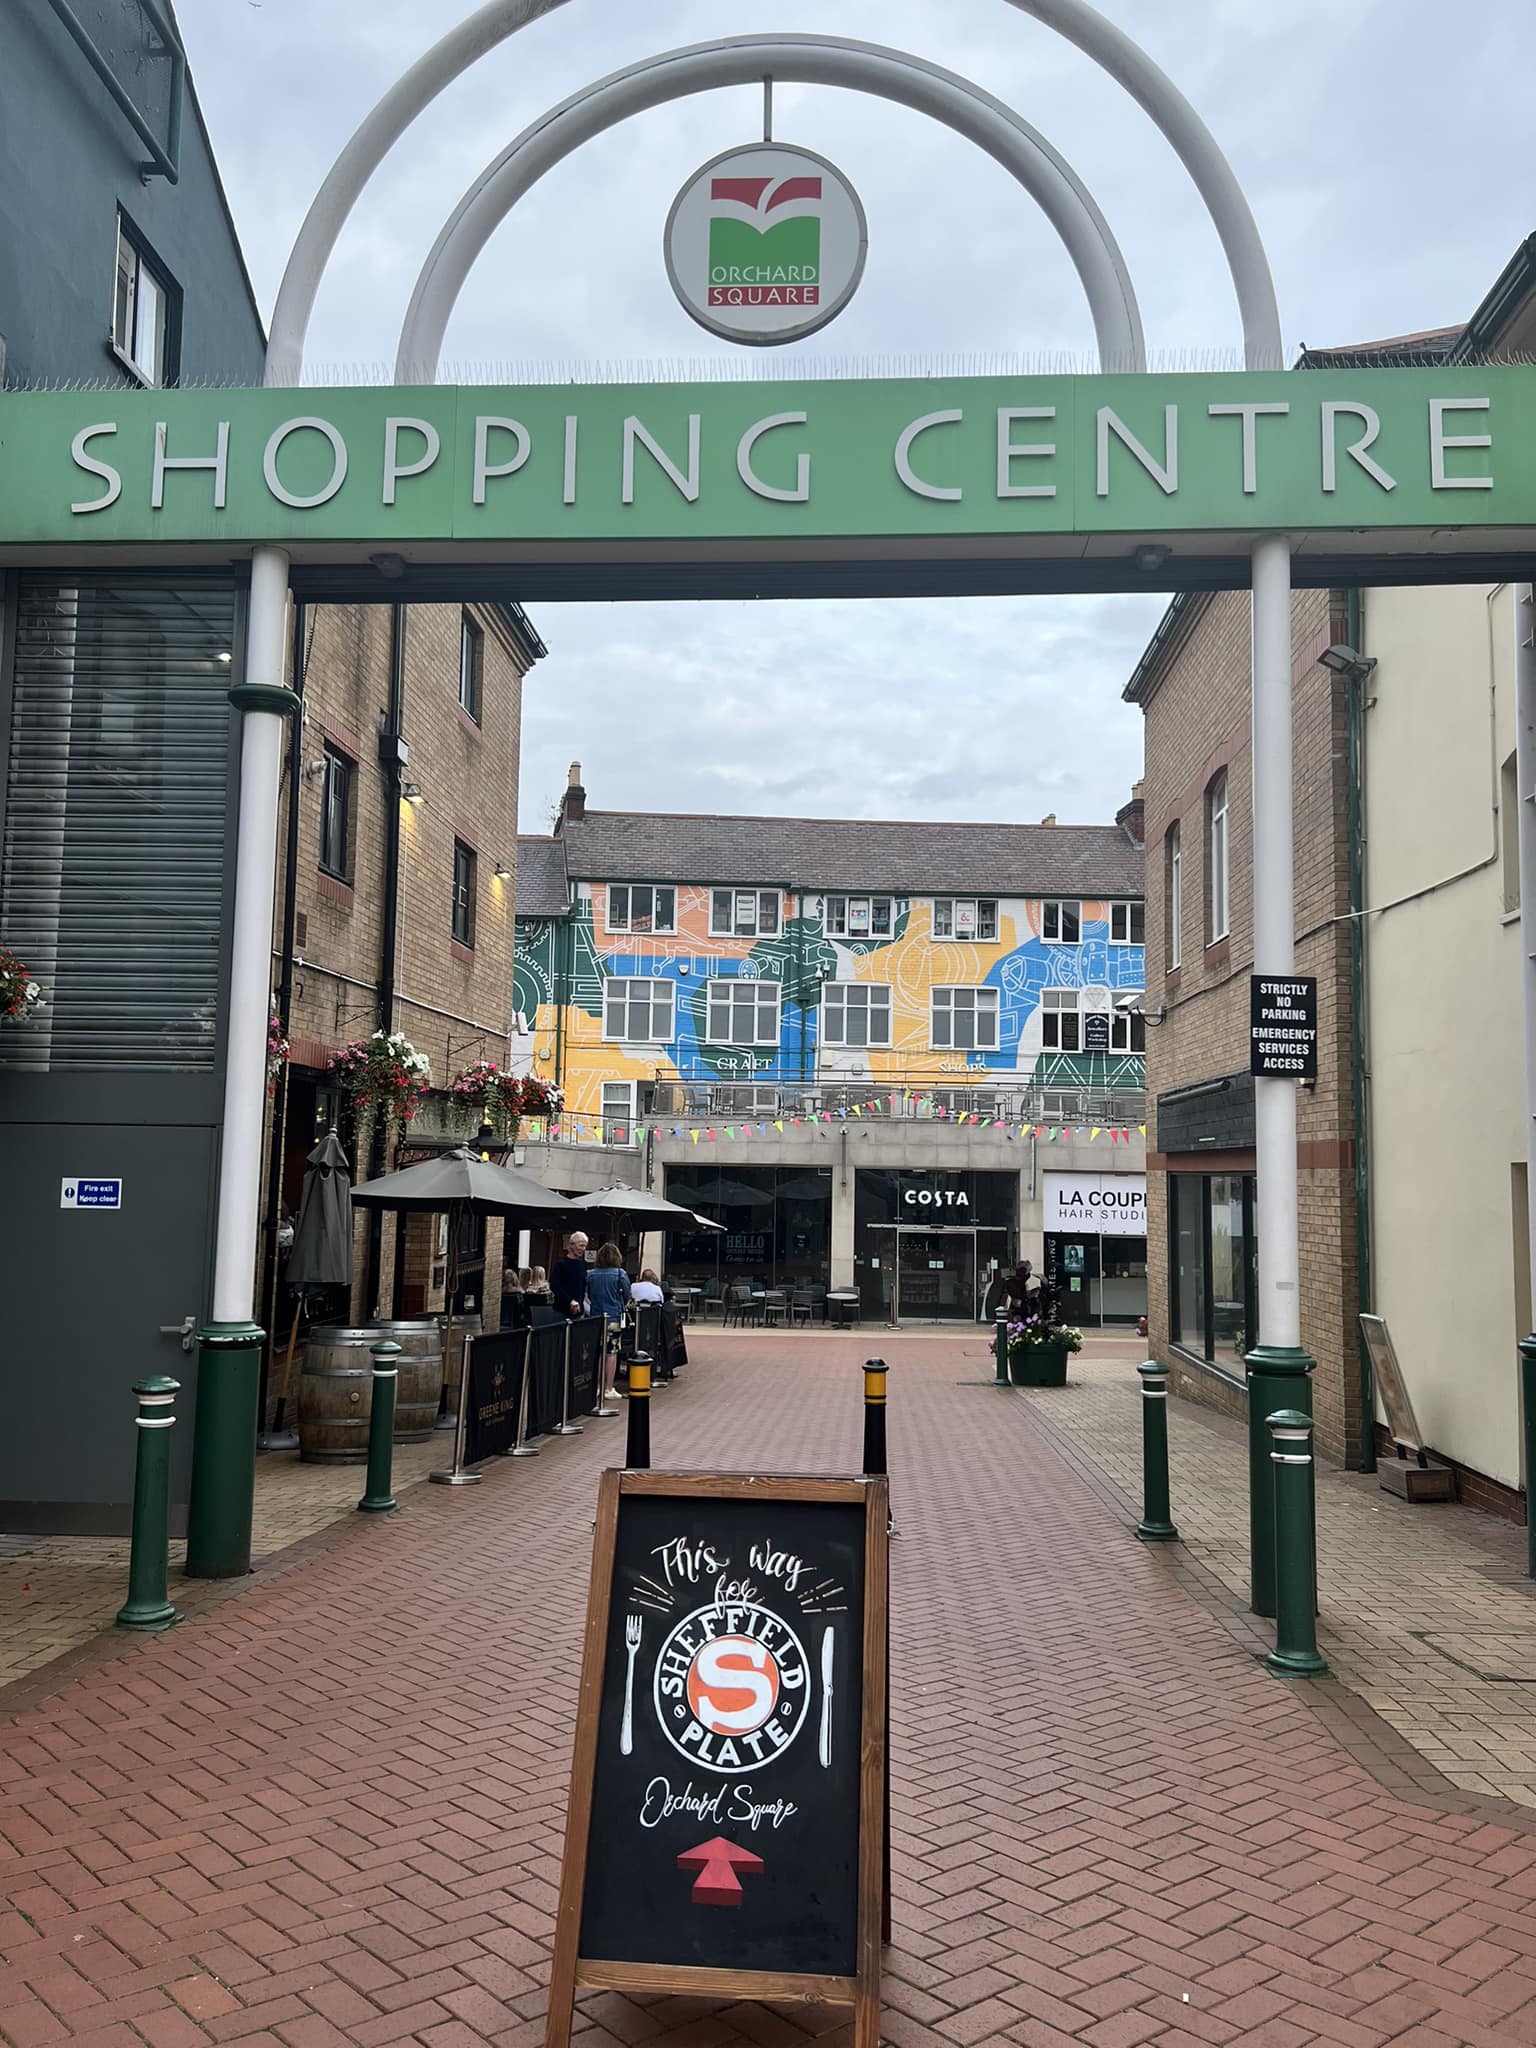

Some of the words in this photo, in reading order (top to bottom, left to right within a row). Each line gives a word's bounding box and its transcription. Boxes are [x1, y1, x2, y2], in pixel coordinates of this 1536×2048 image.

[711, 265, 817, 283] ORCHARD
[712, 287, 815, 306] SQUARE
[70, 410, 811, 514] SHOPPING
[893, 397, 1495, 501] CENTRE
[1259, 983, 1309, 996] STRICTLY
[1276, 996, 1292, 1008] NO
[1261, 1008, 1307, 1021] PARKING
[1252, 1027, 1316, 1041] EMERGENCY
[1258, 1042, 1310, 1055] SERVICES
[717, 1057, 773, 1070] CRAFT
[1263, 1057, 1305, 1070] ACCESS
[84, 1184, 99, 1192] Fire
[99, 1185, 113, 1193] exit
[79, 1194, 98, 1203] Keep
[98, 1195, 117, 1203] clear
[904, 1189, 969, 1207] COSTA
[1059, 1190, 1084, 1206] LA
[1059, 1208, 1094, 1219] HAIR
[1100, 1209, 1145, 1220] STUDI
[726, 1235, 765, 1249] HELLO
[651, 1536, 730, 1587] This
[661, 1607, 805, 1698] SHEFFIELD
[696, 1639, 774, 1731] S
[679, 1717, 790, 1766] PLATE
[639, 1776, 727, 1828] Orchard
[727, 1784, 799, 1832] Square
